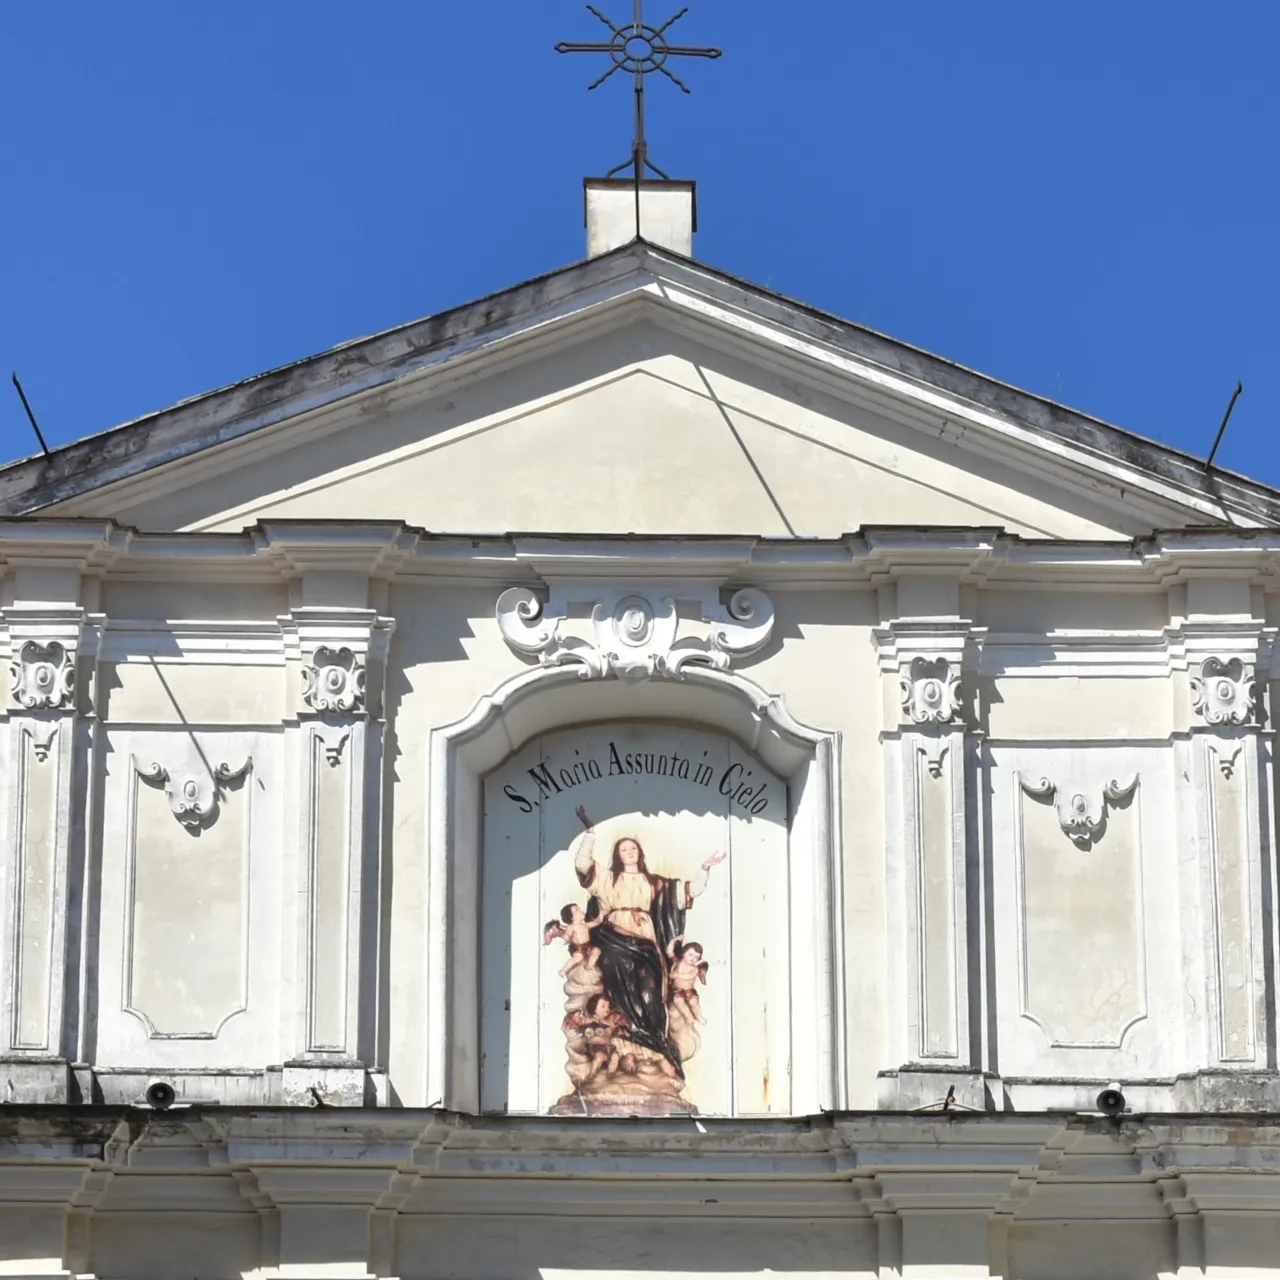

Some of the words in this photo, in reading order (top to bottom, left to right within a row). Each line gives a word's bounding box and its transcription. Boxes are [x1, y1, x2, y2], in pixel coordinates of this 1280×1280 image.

[503, 784, 540, 814] S.
[527, 749, 603, 801] Maria
[607, 742, 690, 780] Assunta
[692, 750, 714, 787] in
[719, 762, 769, 815] Cielo
